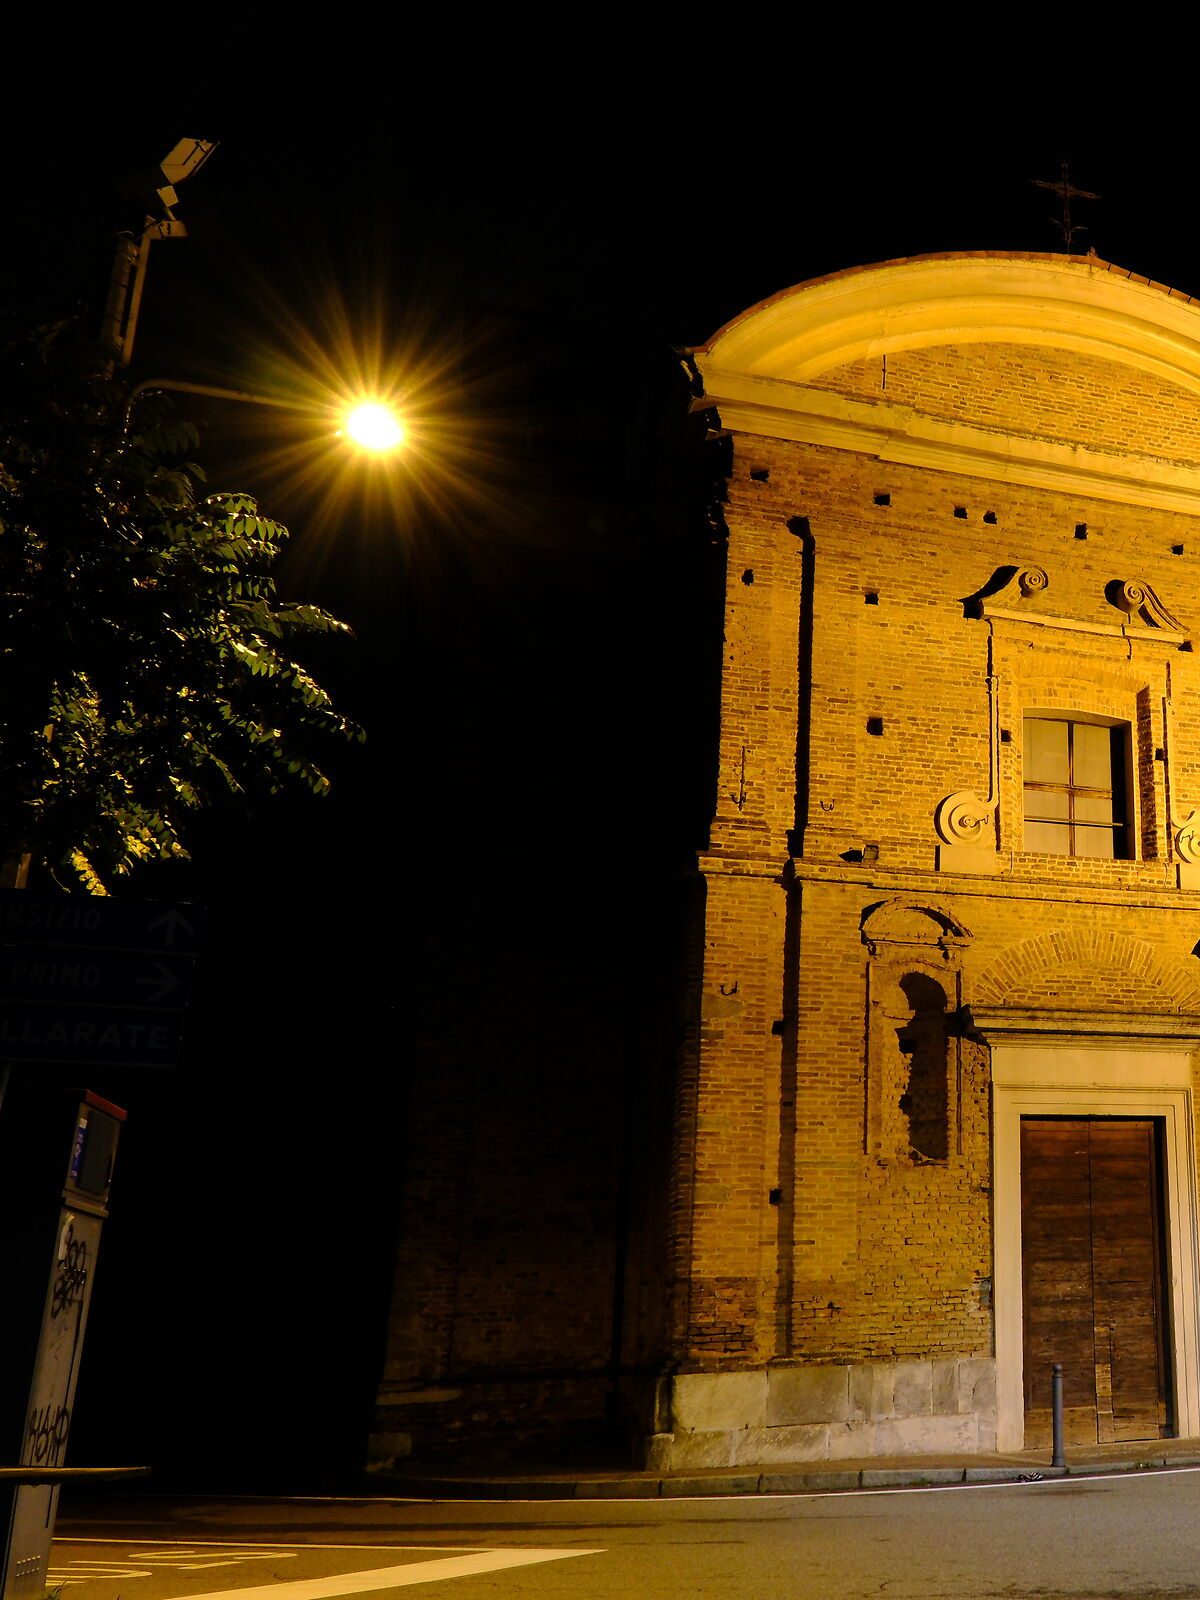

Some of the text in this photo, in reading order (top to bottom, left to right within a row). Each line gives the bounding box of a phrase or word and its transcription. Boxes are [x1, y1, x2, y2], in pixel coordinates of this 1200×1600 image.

[0, 901, 101, 931] RSIZIO
[11, 959, 101, 988] PRIMO
[0, 1014, 169, 1049] LLARATE
[46, 1550, 299, 1588] STO
